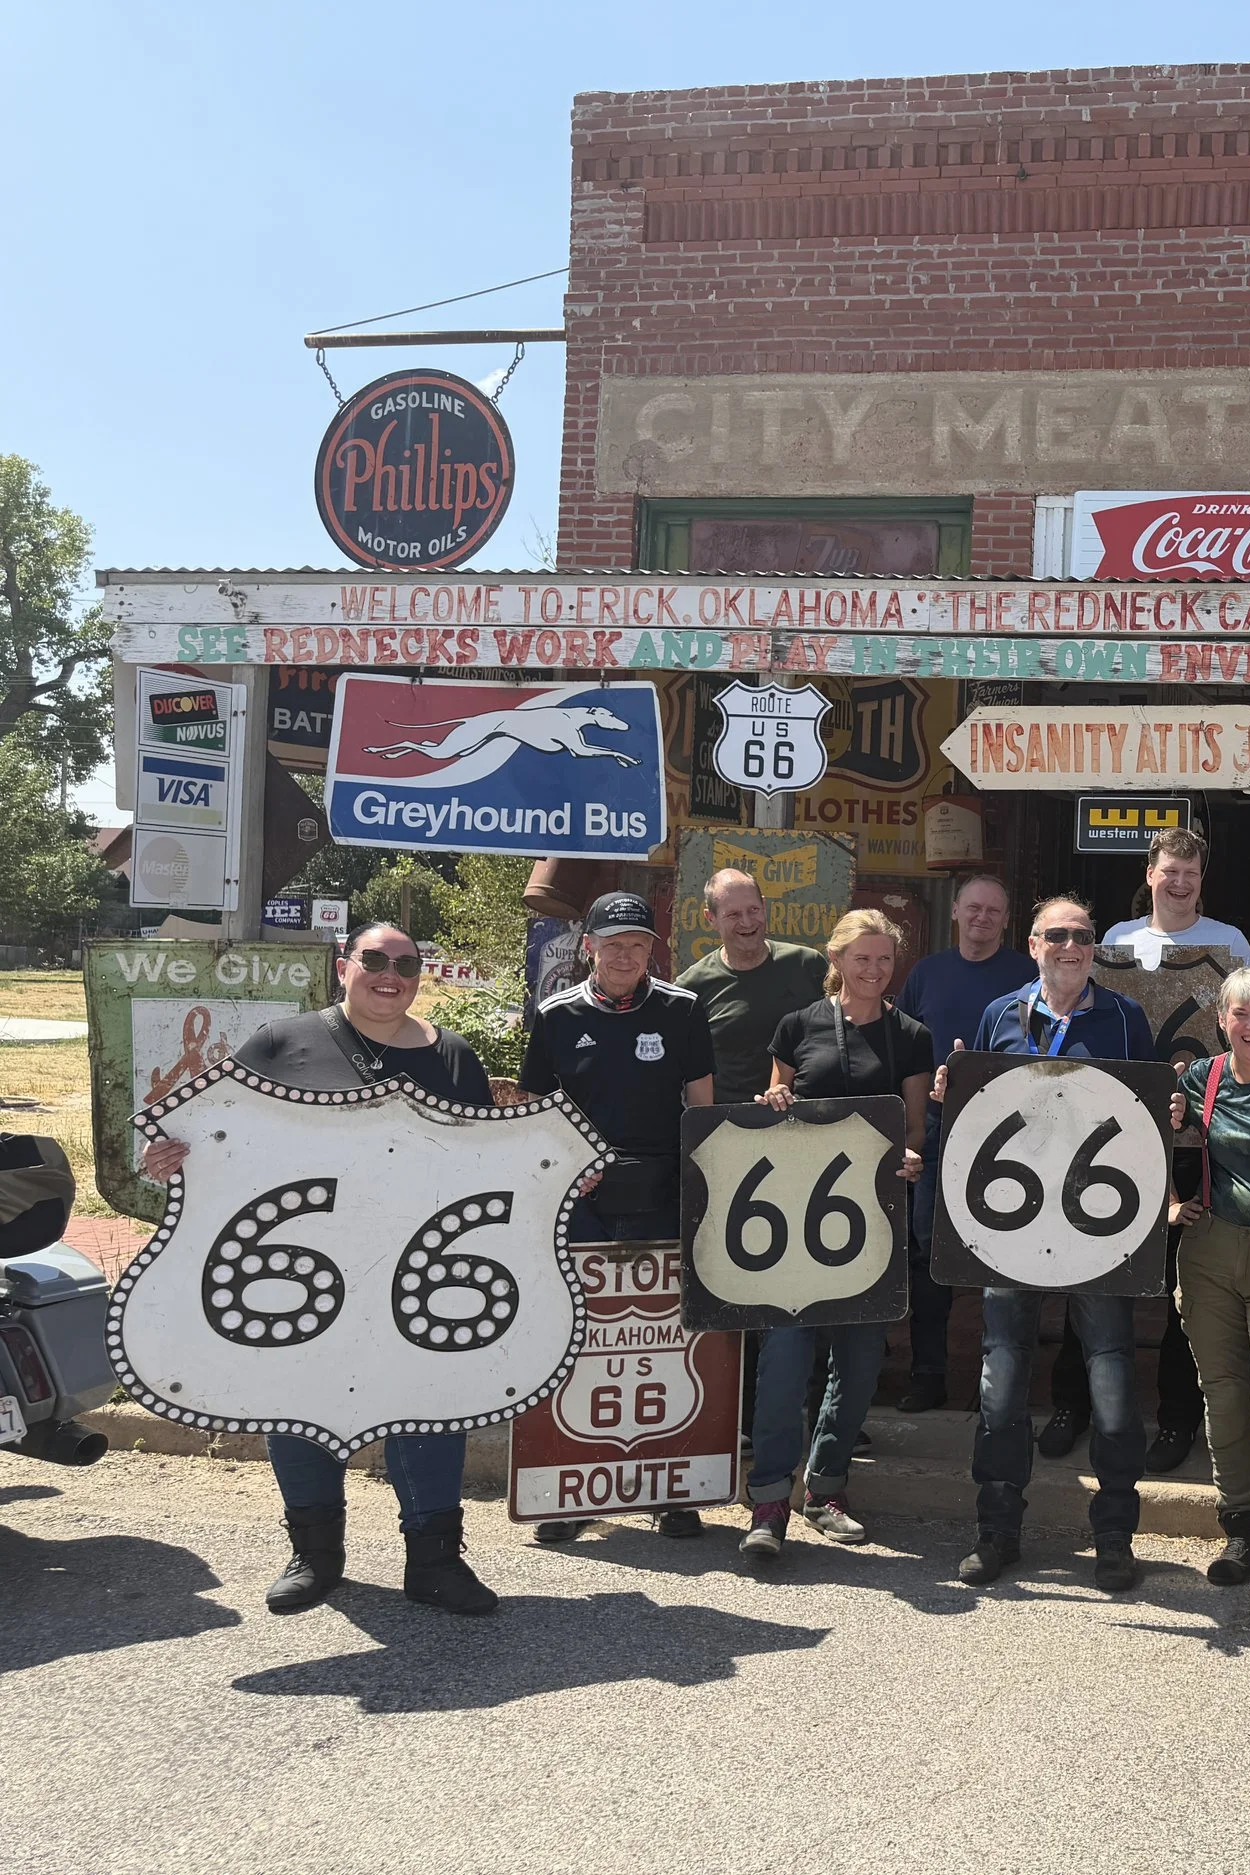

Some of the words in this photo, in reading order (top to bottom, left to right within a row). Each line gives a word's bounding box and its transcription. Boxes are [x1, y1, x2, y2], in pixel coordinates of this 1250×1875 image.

[370, 391, 466, 420] GASOLINE
[635, 390, 882, 465] CITY
[933, 385, 1249, 466] MEAT
[335, 413, 499, 529] Phillips
[357, 527, 422, 558] MOTOR
[428, 526, 468, 557] OILS
[340, 585, 501, 623] WELCOME
[518, 586, 562, 623] TO
[699, 587, 905, 630] OKLAHOMA
[1028, 590, 1207, 632] REDNECK
[177, 626, 248, 663] SEE
[263, 626, 480, 664] REDNECKS
[494, 628, 623, 667] WORK
[629, 630, 723, 670] AND
[728, 631, 839, 672] PLAY
[851, 636, 898, 674] IN
[914, 639, 1042, 678] THEIR
[1060, 640, 1151, 680] OWN
[153, 694, 217, 716] DISCOVER
[751, 696, 792, 714] ROUTE
[743, 739, 795, 780] 66
[969, 722, 1129, 774] INSANITY
[1135, 723, 1173, 774] AT
[157, 777, 212, 807] VISA
[695, 774, 737, 809] STAMPS
[353, 791, 571, 839] Greyhound
[585, 803, 646, 840] Bus
[795, 797, 918, 826] LOTHES
[1088, 829, 1139, 840] western
[763, 859, 805, 883] GIVE
[265, 905, 301, 918] ICE
[322, 911, 336, 919] 66
[116, 952, 197, 985] We
[215, 952, 312, 987] Give
[351, 1053, 376, 1084] Calvin
[965, 1109, 1141, 1237] 66
[725, 1150, 867, 1272] 66
[201, 1177, 520, 1352] 66
[582, 1252, 681, 1295] STOR
[587, 1324, 685, 1348] KLAHOMA
[590, 1382, 667, 1429] 66
[558, 1460, 691, 1509] ROUTE
